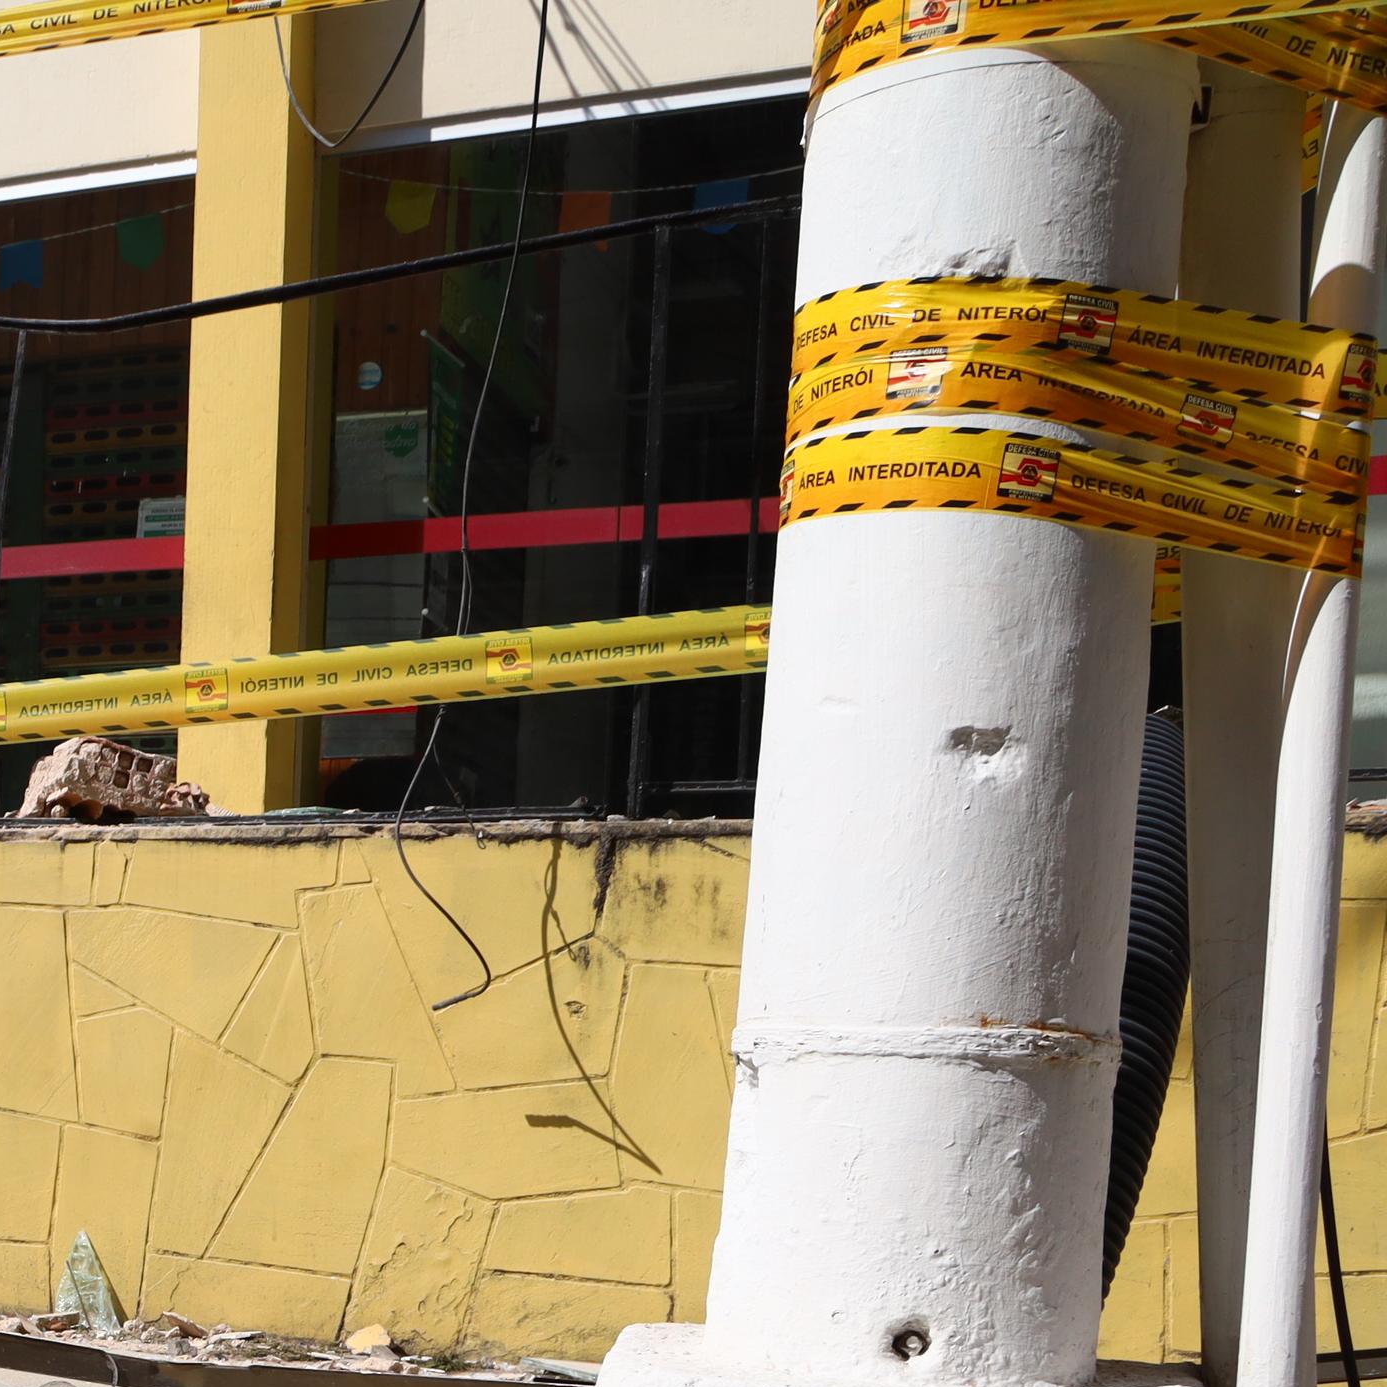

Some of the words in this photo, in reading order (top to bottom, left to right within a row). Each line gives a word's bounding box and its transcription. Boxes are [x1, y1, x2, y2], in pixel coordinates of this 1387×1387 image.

[30, 13, 78, 30] CIVIL
[92, 7, 119, 20] DE
[1285, 36, 1317, 57] DE
[796, 322, 838, 350] DEFESA
[850, 314, 895, 332] CIVIL
[912, 308, 941, 323] DE
[957, 305, 1047, 324] NITERÓI
[1127, 325, 1182, 352] ÁREA
[1196, 341, 1325, 379] INTERDITADA
[811, 367, 873, 401] NITERÓI
[799, 466, 835, 491] ÁREA
[848, 461, 982, 482] INTERDITADA
[1071, 474, 1147, 502] DEFESA
[1161, 492, 1209, 516] CIVIL
[1223, 503, 1254, 524] DE
